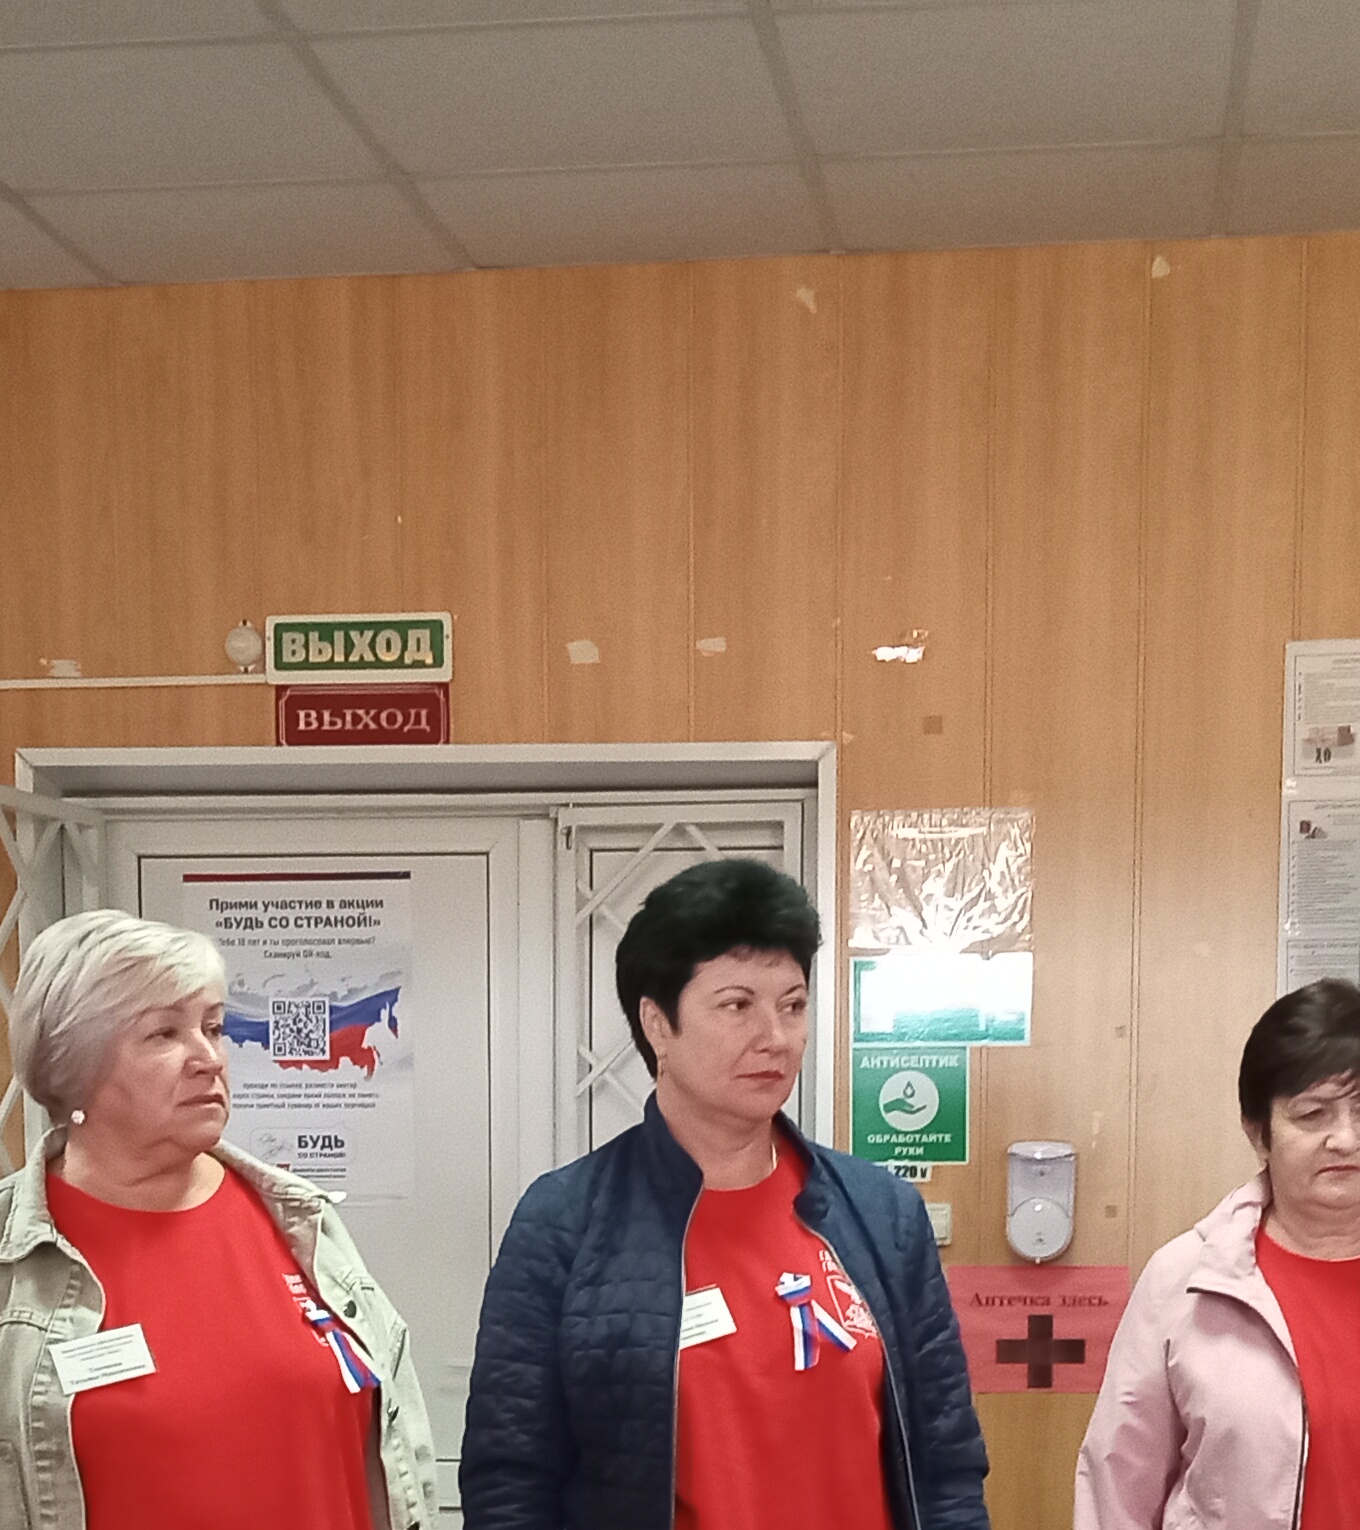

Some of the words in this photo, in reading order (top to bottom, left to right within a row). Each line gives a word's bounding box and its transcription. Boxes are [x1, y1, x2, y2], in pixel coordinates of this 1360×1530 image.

[281, 628, 433, 665] ВЫХОД
[295, 708, 430, 733] ВЫХОД
[209, 898, 258, 913] Прими
[262, 898, 322, 913] участие
[326, 899, 335, 909] в
[339, 898, 384, 912] акции
[215, 916, 264, 931] «БУДЬ
[268, 916, 290, 929] СО
[293, 912, 381, 929] СТРАНОЙ!»
[860, 1055, 960, 1069] АНТИСЕПТИК
[297, 1135, 345, 1151] БУДЬ
[867, 1133, 952, 1144] ОБРАБОТАЙТЕ
[894, 1146, 924, 1156] РУКИ
[894, 1165, 918, 1178] 220
[970, 1292, 1051, 1307] Аптечка
[1059, 1295, 1109, 1308] здесь
